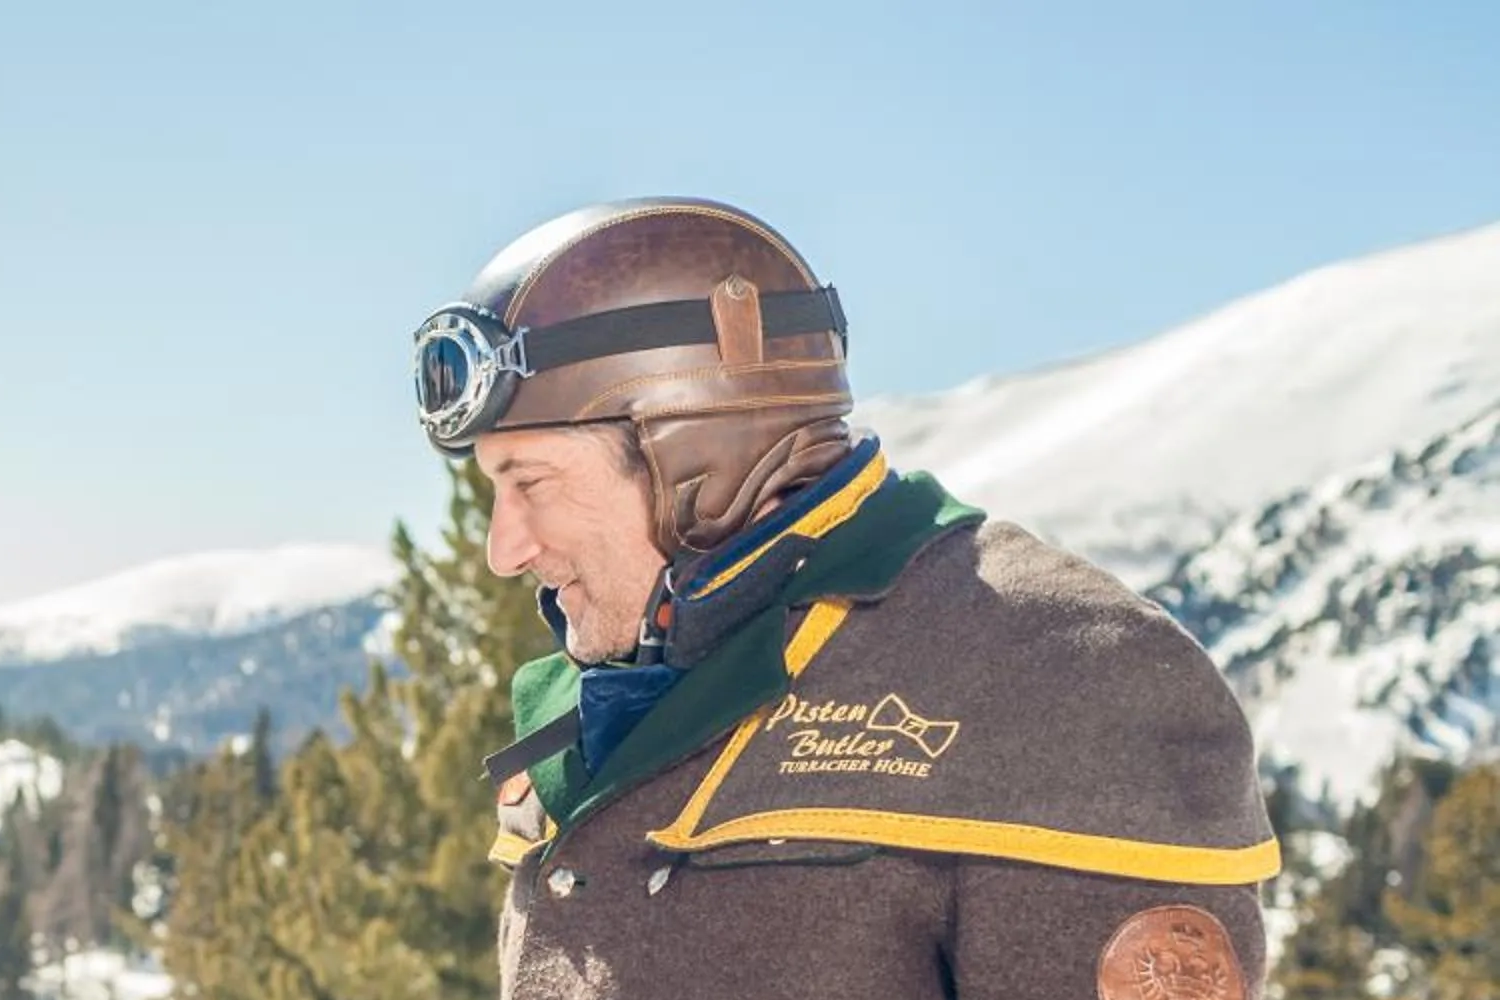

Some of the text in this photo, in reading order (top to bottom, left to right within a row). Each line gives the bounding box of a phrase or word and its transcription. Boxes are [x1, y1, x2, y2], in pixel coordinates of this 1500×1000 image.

[765, 692, 867, 731] Pisten
[787, 729, 894, 757] Butler
[779, 756, 933, 777] TURRACHER HÖHE
